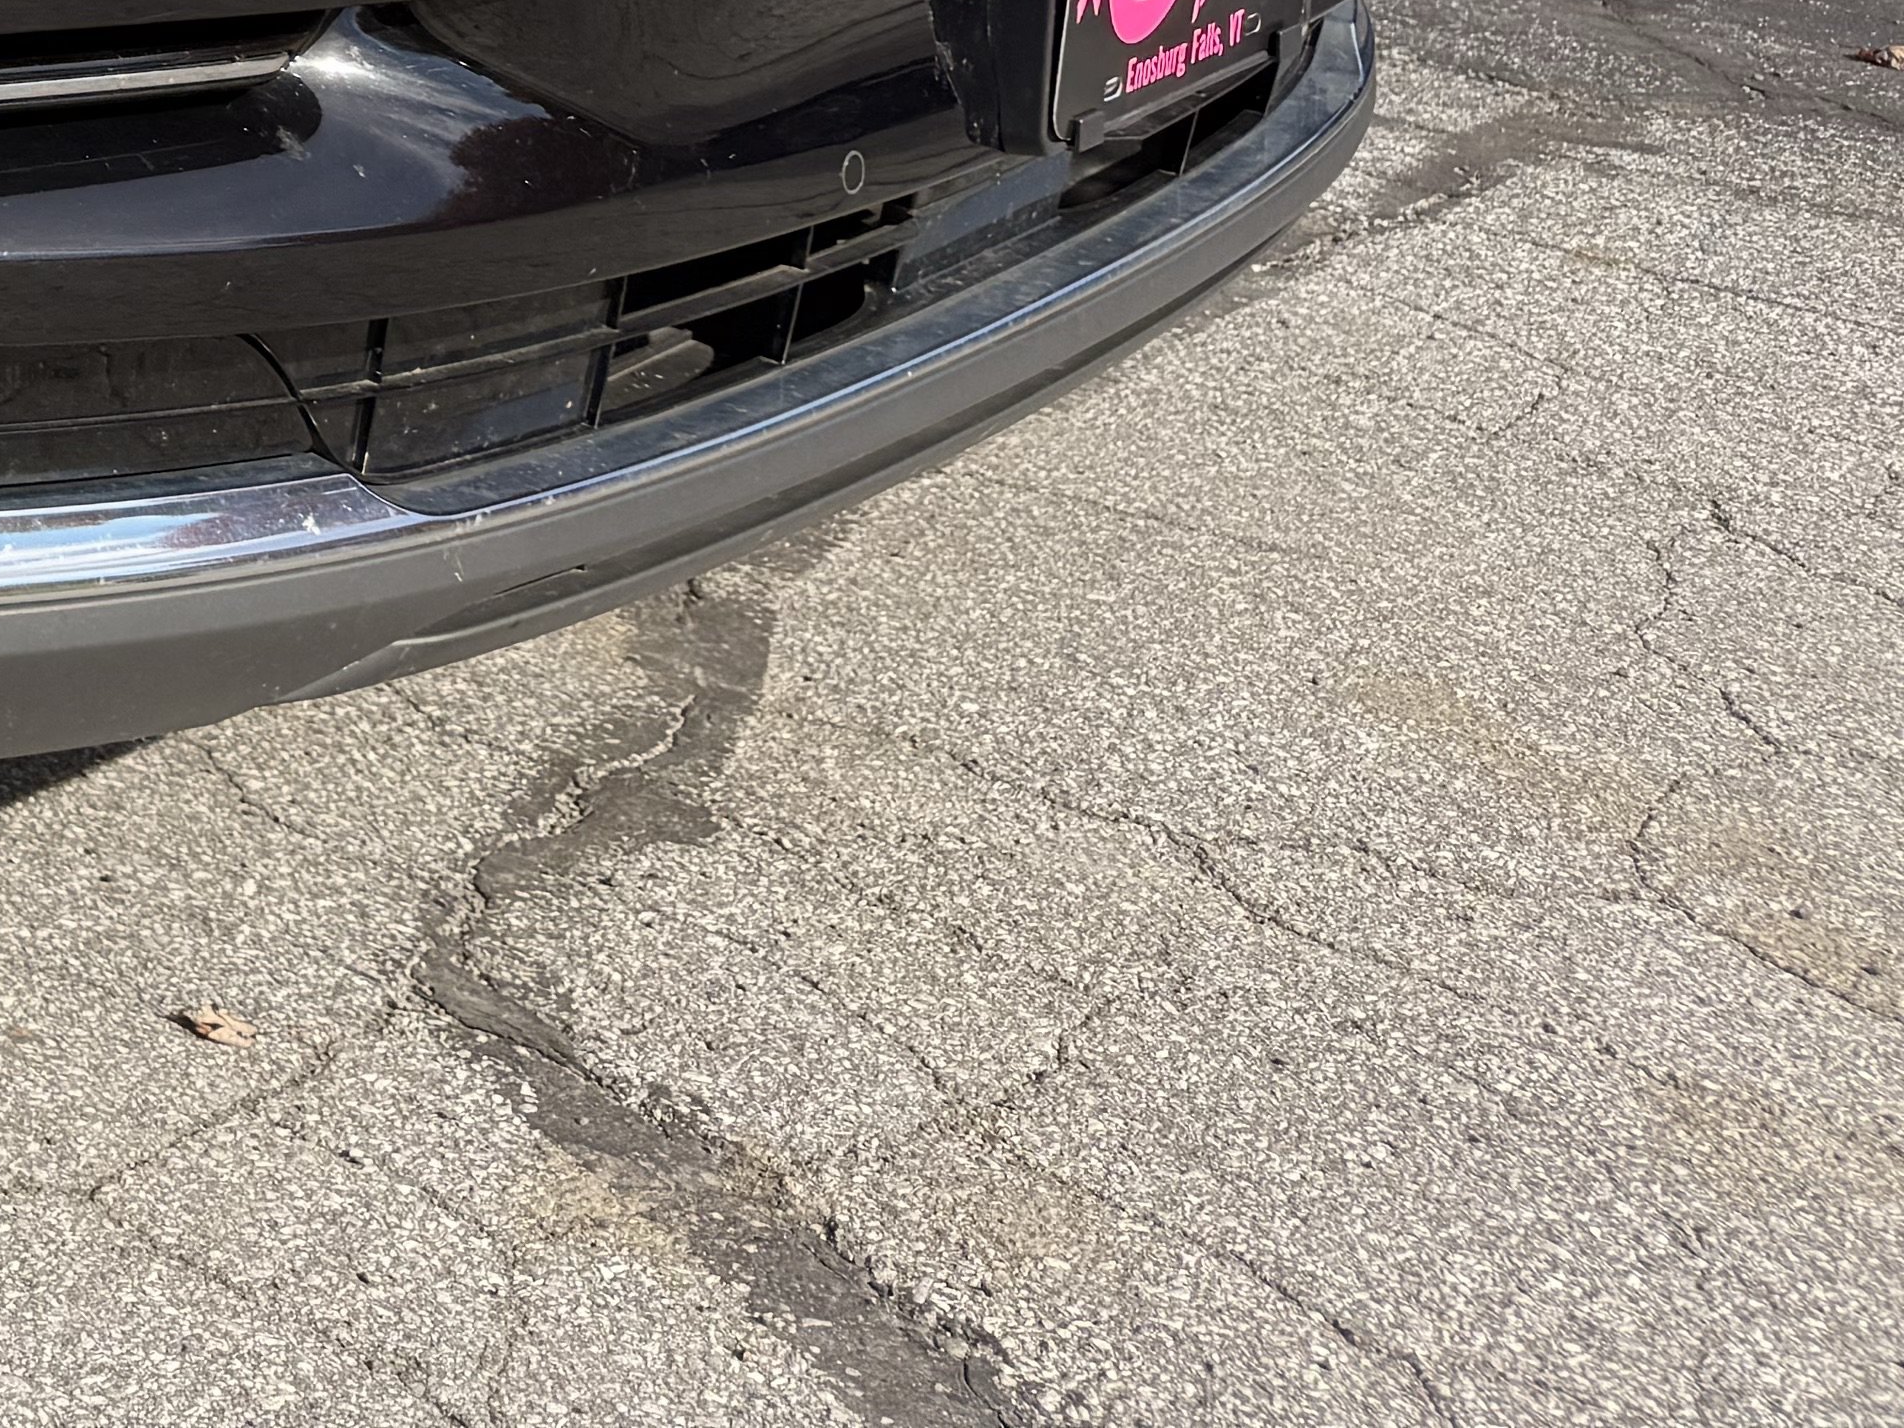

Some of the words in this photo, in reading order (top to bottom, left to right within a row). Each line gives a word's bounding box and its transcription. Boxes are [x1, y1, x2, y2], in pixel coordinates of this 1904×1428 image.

[1125, 42, 1189, 94] Enosburg
[1190, 22, 1224, 64] Falls,
[1229, 8, 1246, 47] VT
